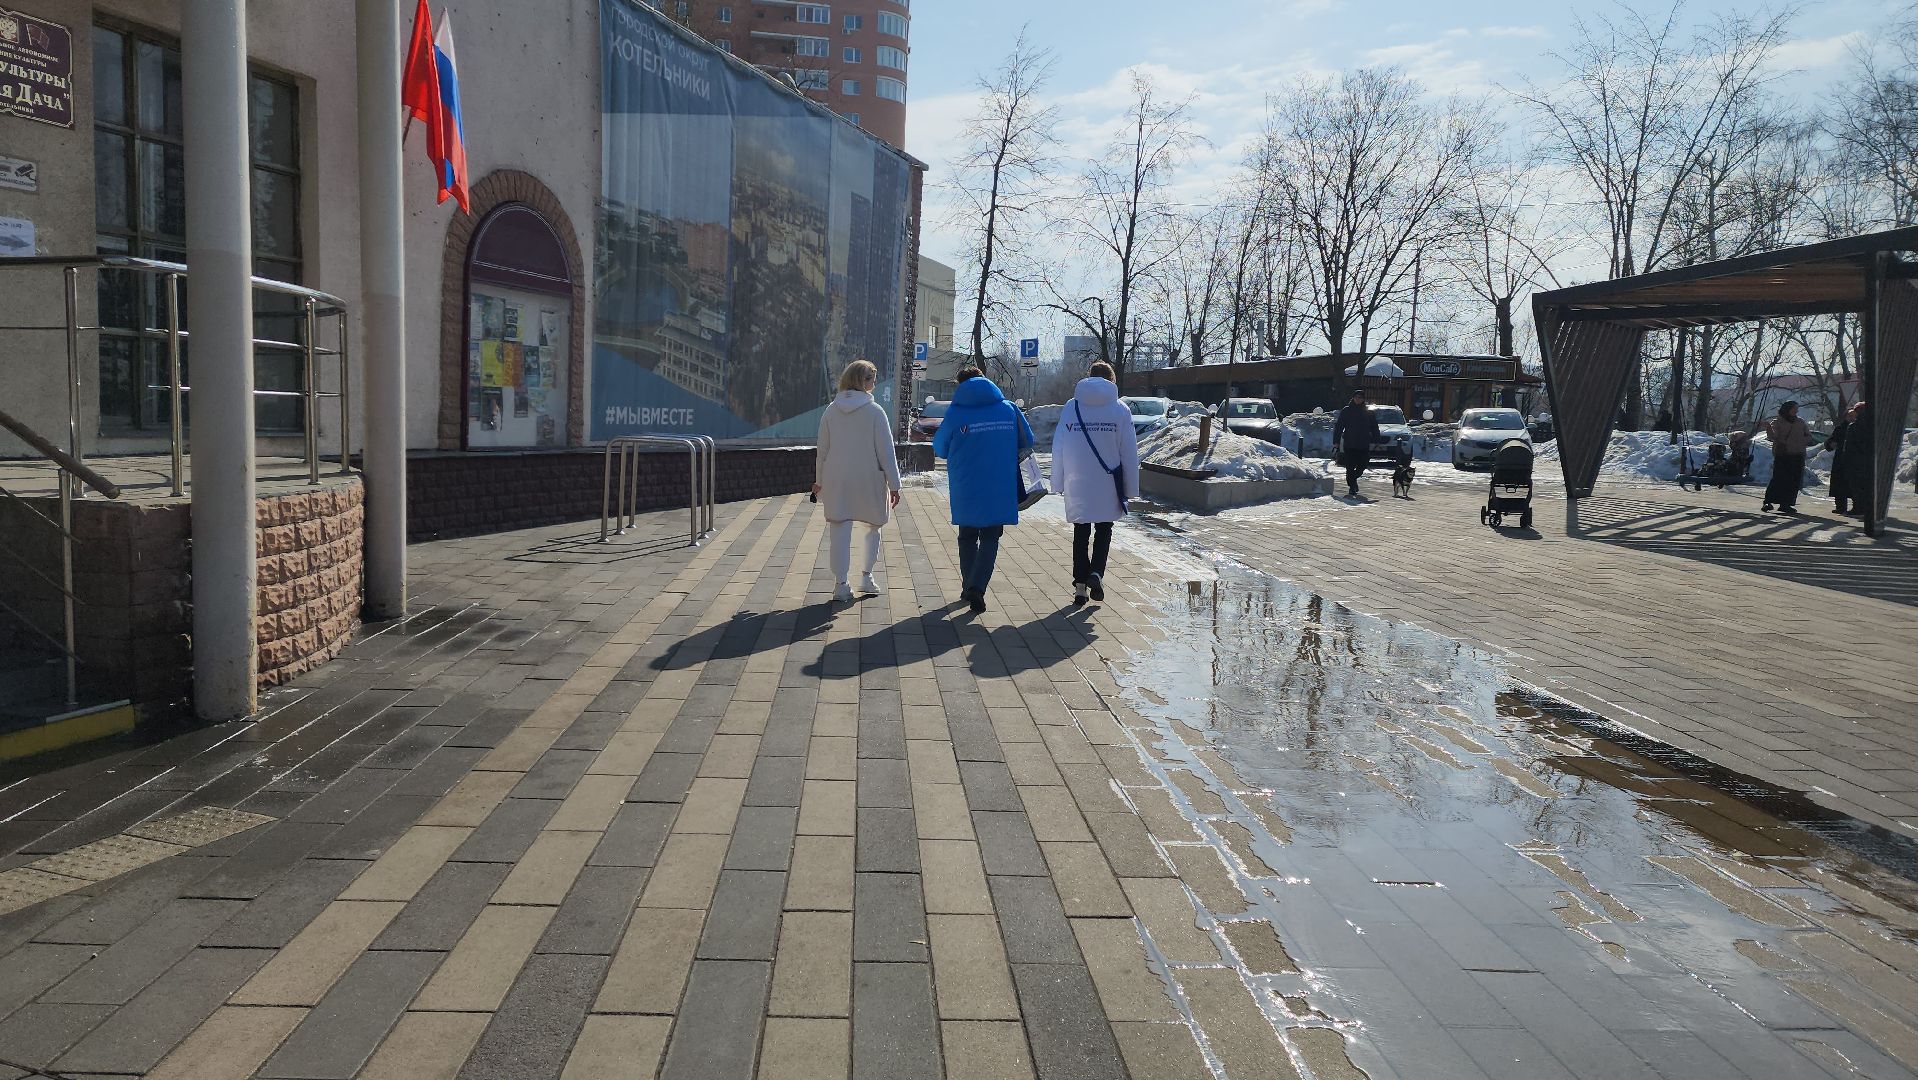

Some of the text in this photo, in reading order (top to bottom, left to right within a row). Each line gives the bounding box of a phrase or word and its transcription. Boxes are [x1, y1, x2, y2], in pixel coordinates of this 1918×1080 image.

[609, 31, 710, 100] КОТЕЛЬНИКИ
[915, 344, 925, 359] P
[1026, 341, 1036, 355] P
[605, 406, 695, 425] #МЫВМЕСТЕ
